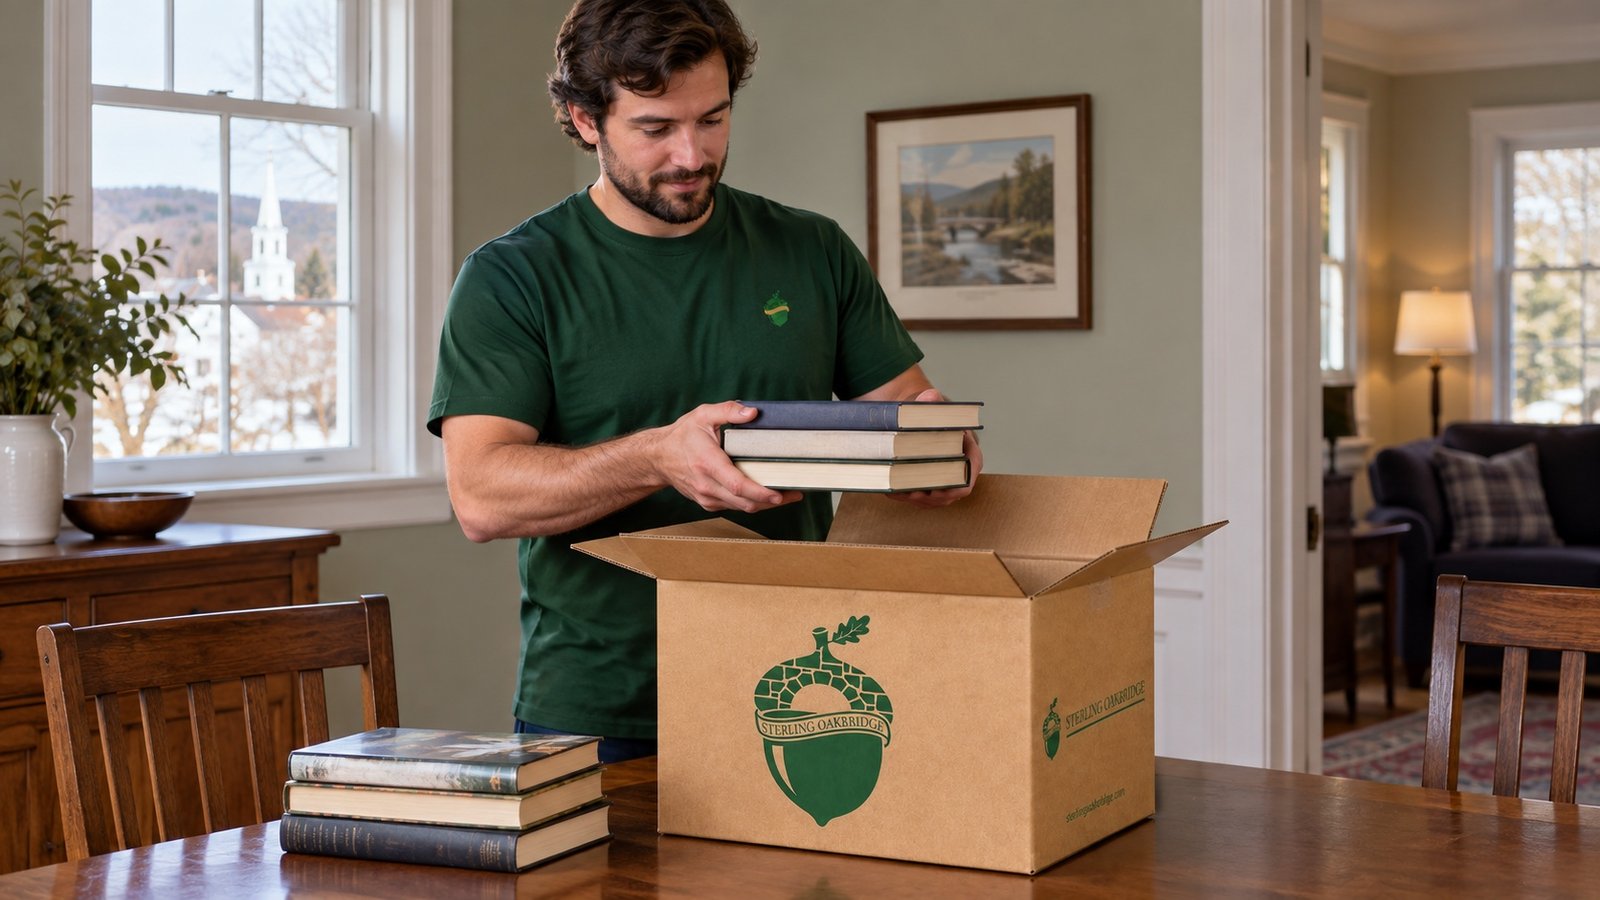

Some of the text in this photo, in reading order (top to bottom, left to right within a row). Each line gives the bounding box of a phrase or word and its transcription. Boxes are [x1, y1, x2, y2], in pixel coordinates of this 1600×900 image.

[761, 716, 884, 736] STERLING OAKBRIDGE
[1065, 700, 1103, 730] STERLING
